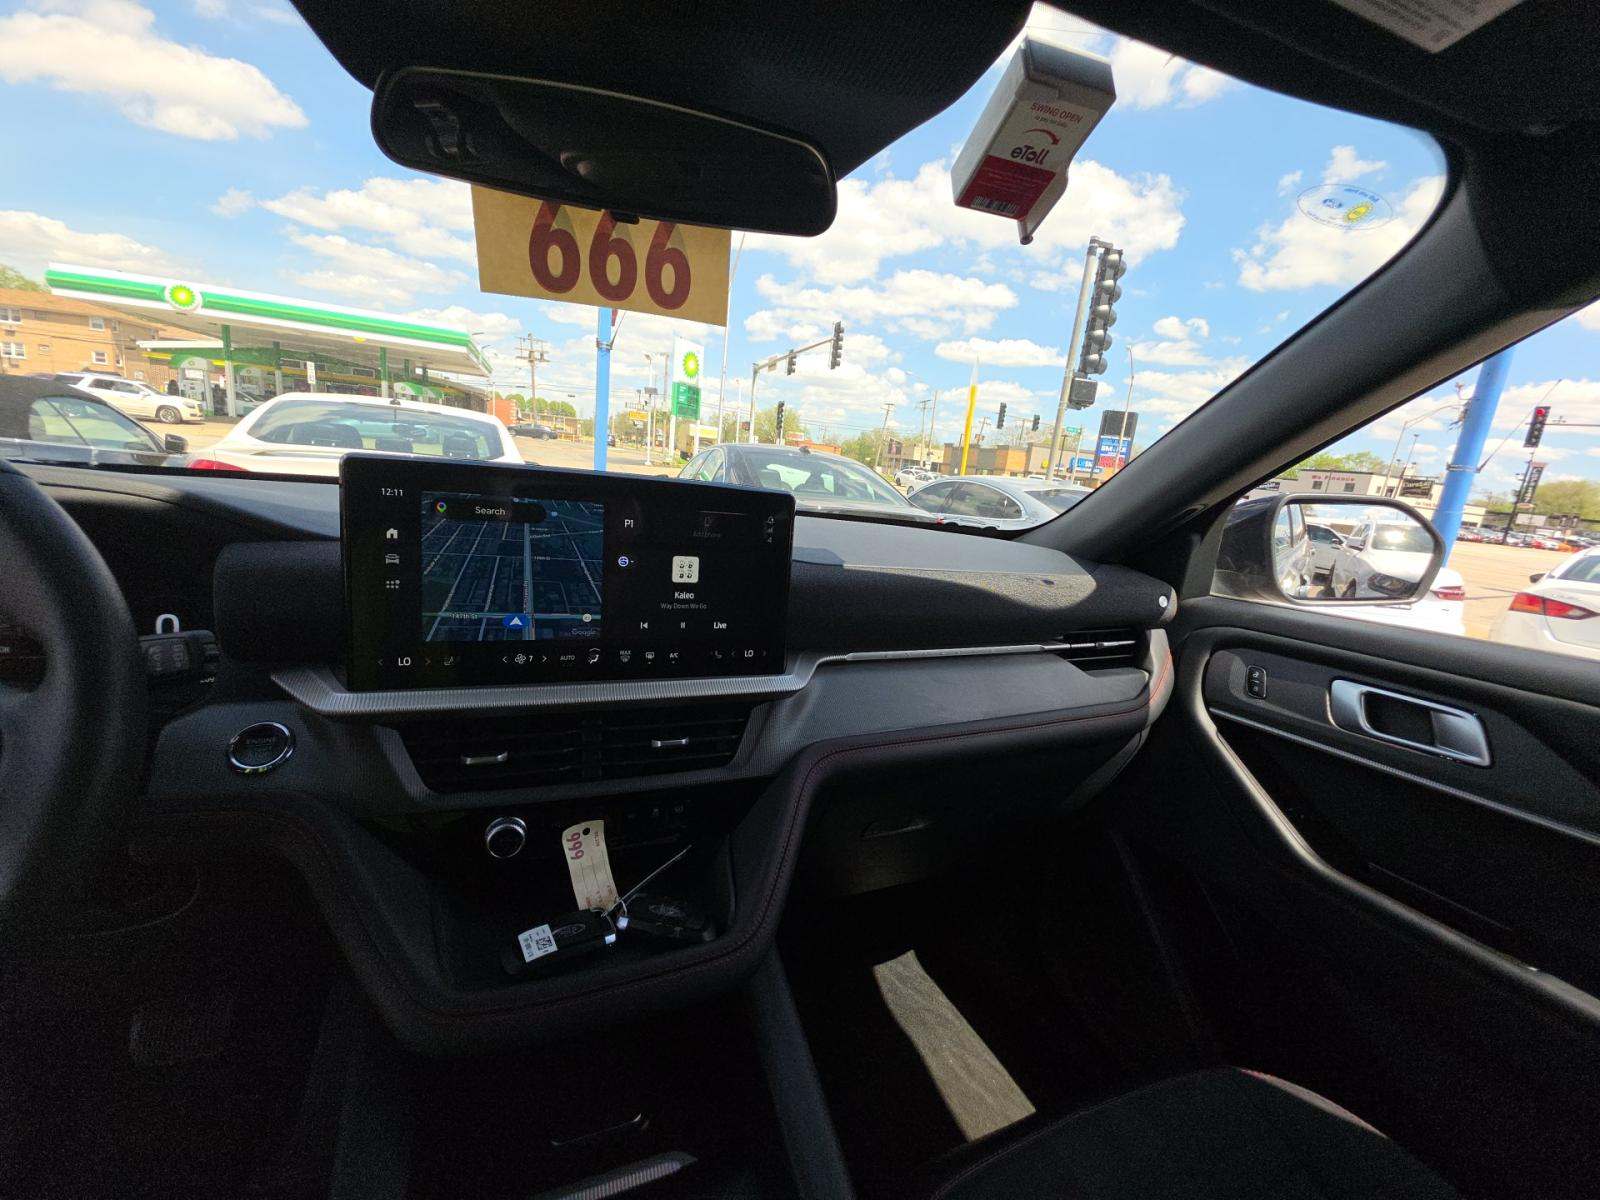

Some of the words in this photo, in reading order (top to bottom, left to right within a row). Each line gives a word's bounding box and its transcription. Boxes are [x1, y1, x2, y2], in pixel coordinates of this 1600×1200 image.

[1031, 102, 1060, 117] SWING
[1058, 110, 1083, 125] OPEN
[1011, 145, 1049, 164] eToll
[528, 199, 692, 311] 666
[381, 488, 403, 496] 12:11
[475, 506, 505, 515] Search
[559, 654, 575, 662] AUTO
[744, 649, 754, 658] LO
[398, 657, 411, 666] LO
